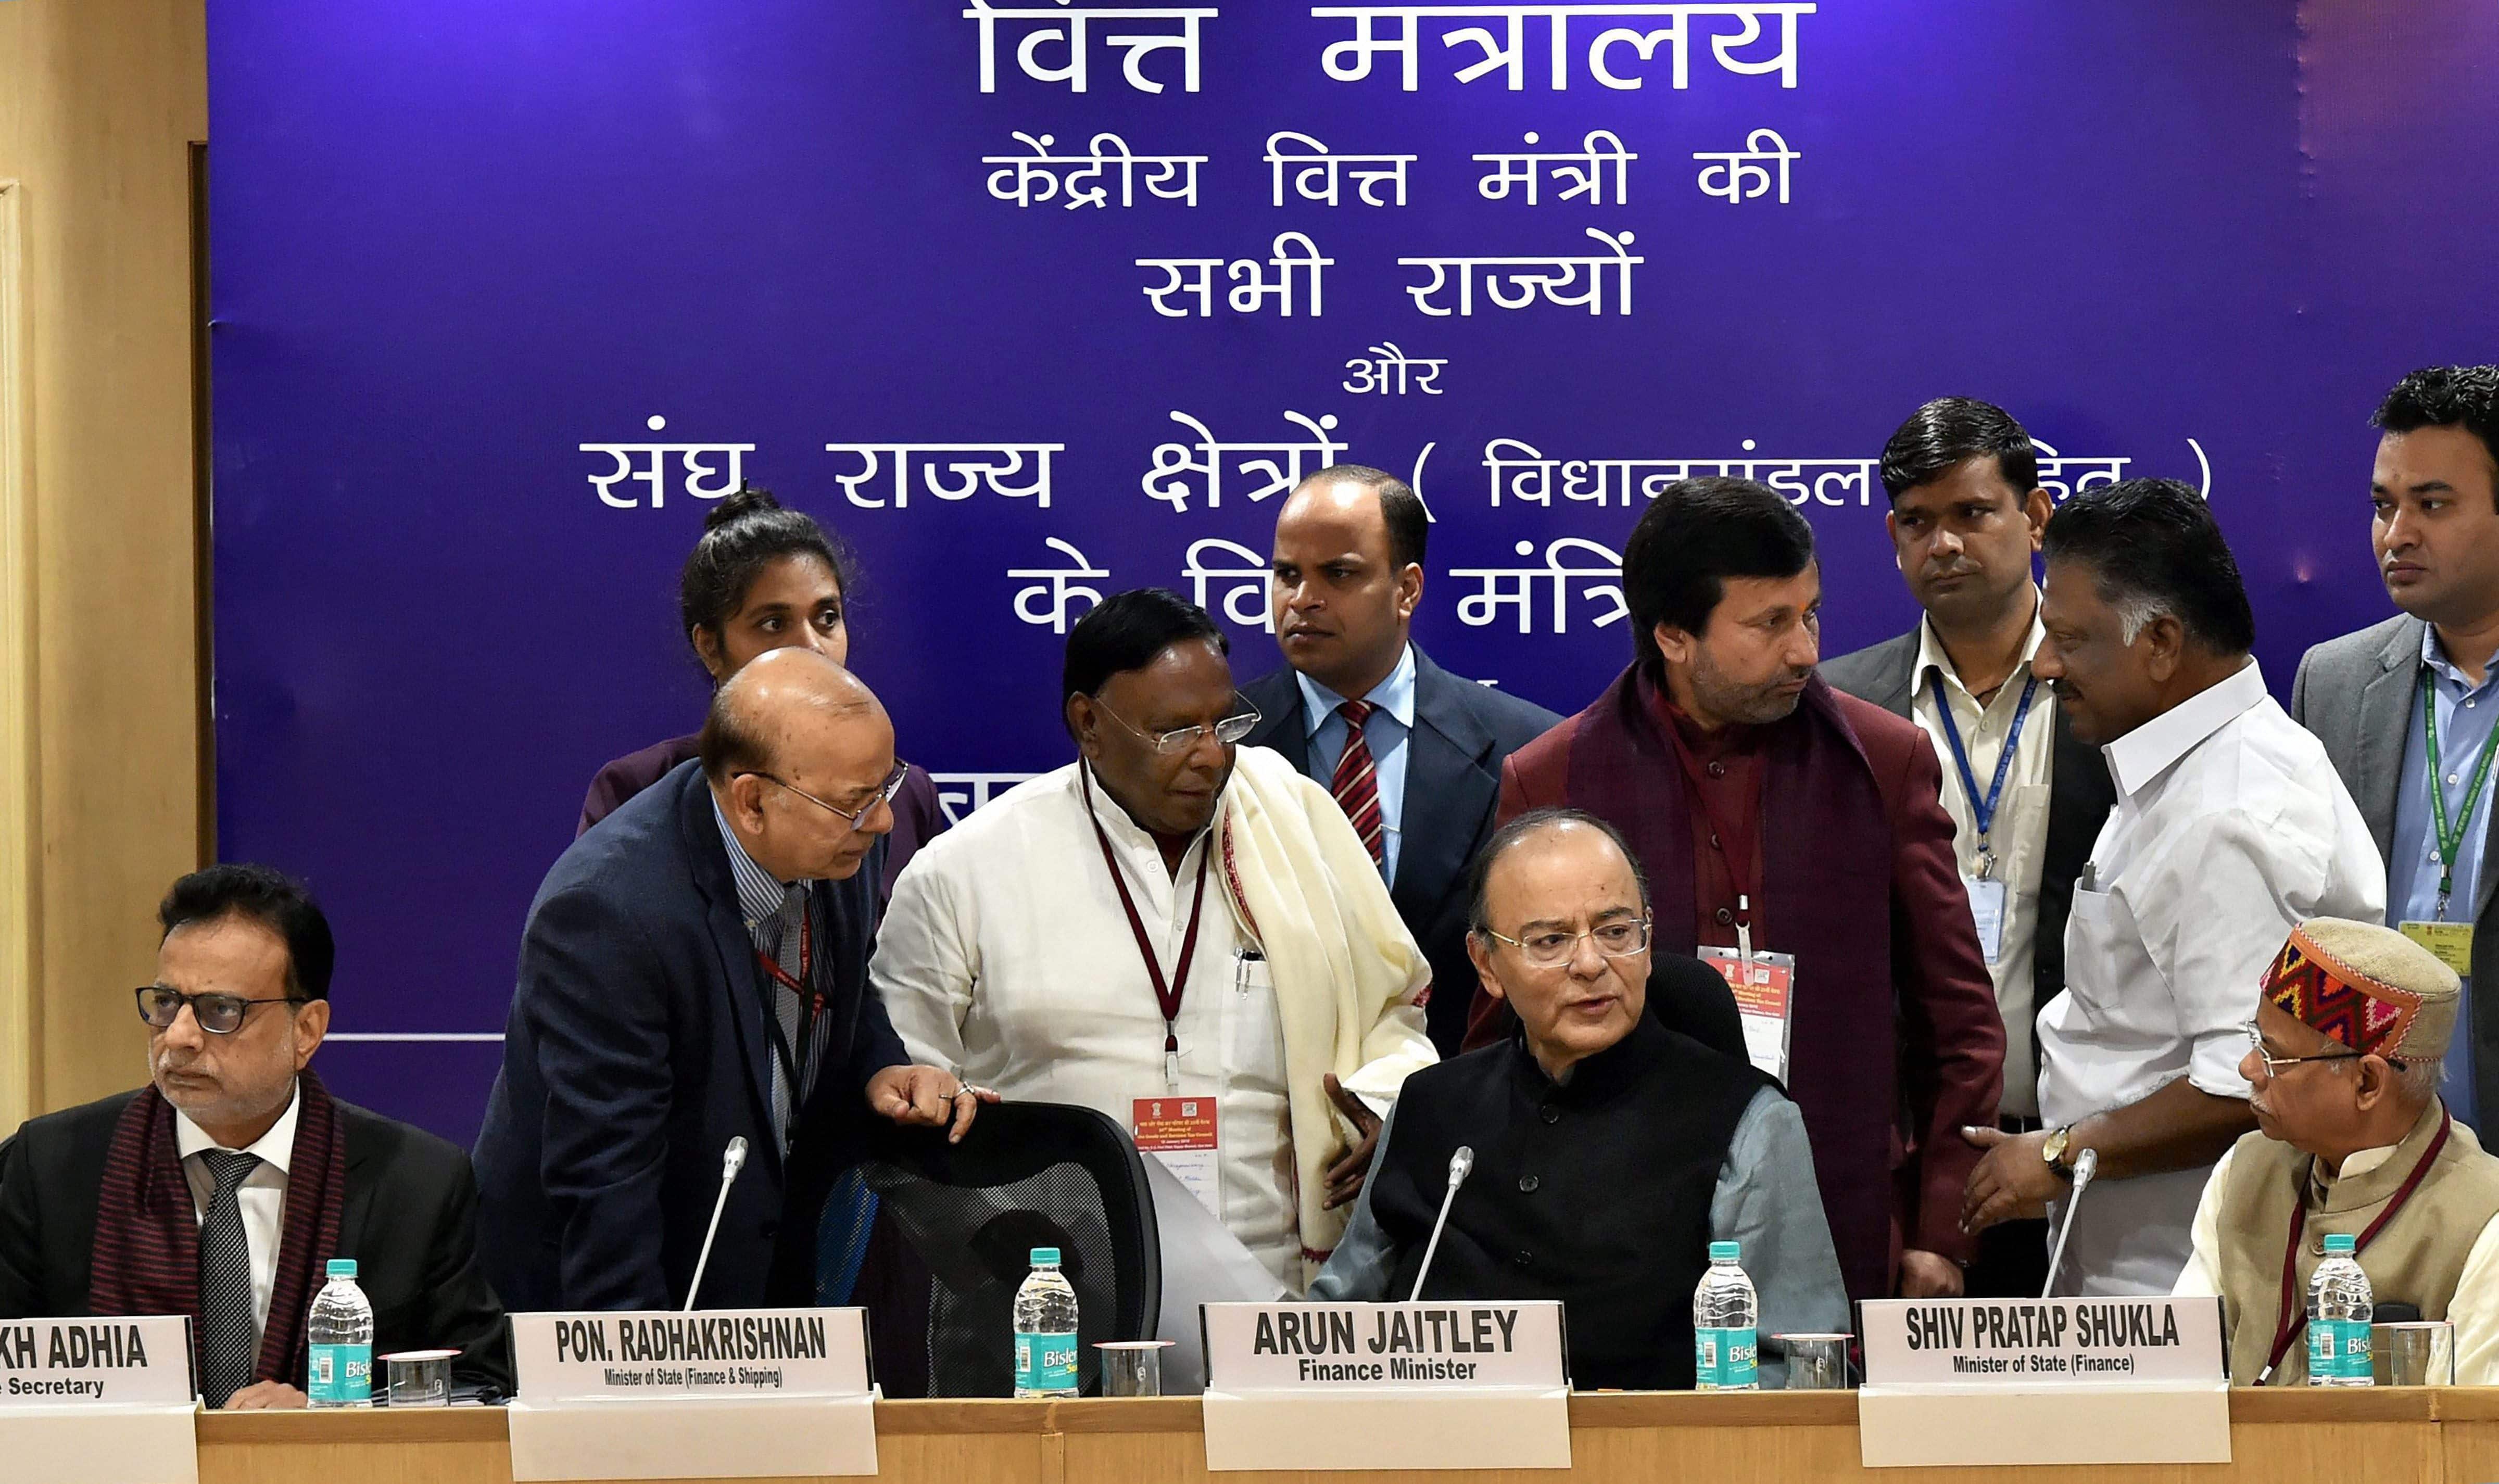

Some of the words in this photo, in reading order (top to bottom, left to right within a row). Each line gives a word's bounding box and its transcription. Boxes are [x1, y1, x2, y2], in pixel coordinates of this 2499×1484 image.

[982, 131, 1208, 210] केंद्रीय
[1263, 131, 1417, 207] वित्त
[1472, 130, 1638, 205] मंत्री
[1693, 129, 1801, 204] की
[1135, 232, 1334, 317] सभी
[1397, 227, 1644, 316] राज्यों
[1343, 341, 1448, 395] और
[579, 415, 755, 508] संघ
[826, 443, 1065, 508] राज्य
[1007, 537, 1109, 634] के
[48, 1325, 148, 1368] ADHIA
[555, 1319, 613, 1363] PON.
[619, 1317, 826, 1362] RADHAKRISHNAN
[1253, 1311, 1355, 1355] ARUN
[1368, 1310, 1518, 1354] JAITLEY
[1906, 1307, 1964, 1350] SHIV
[1972, 1305, 2067, 1349] PRATAP
[2076, 1304, 2180, 1348] SHUKLA
[604, 1368, 642, 1386] Minister
[645, 1368, 654, 1385] of
[657, 1368, 683, 1385] State
[685, 1367, 726, 1389] (Finance
[728, 1367, 736, 1385] &
[738, 1366, 782, 1388] Shipping)
[1298, 1359, 1383, 1381] Finance
[1390, 1358, 1476, 1380] Minister
[1953, 1355, 2009, 1373] Minister
[2012, 1354, 2026, 1373] of
[2030, 1354, 2066, 1372] State
[2071, 1353, 2135, 1376] (Finance)
[8, 1377, 104, 1399] Secretary
